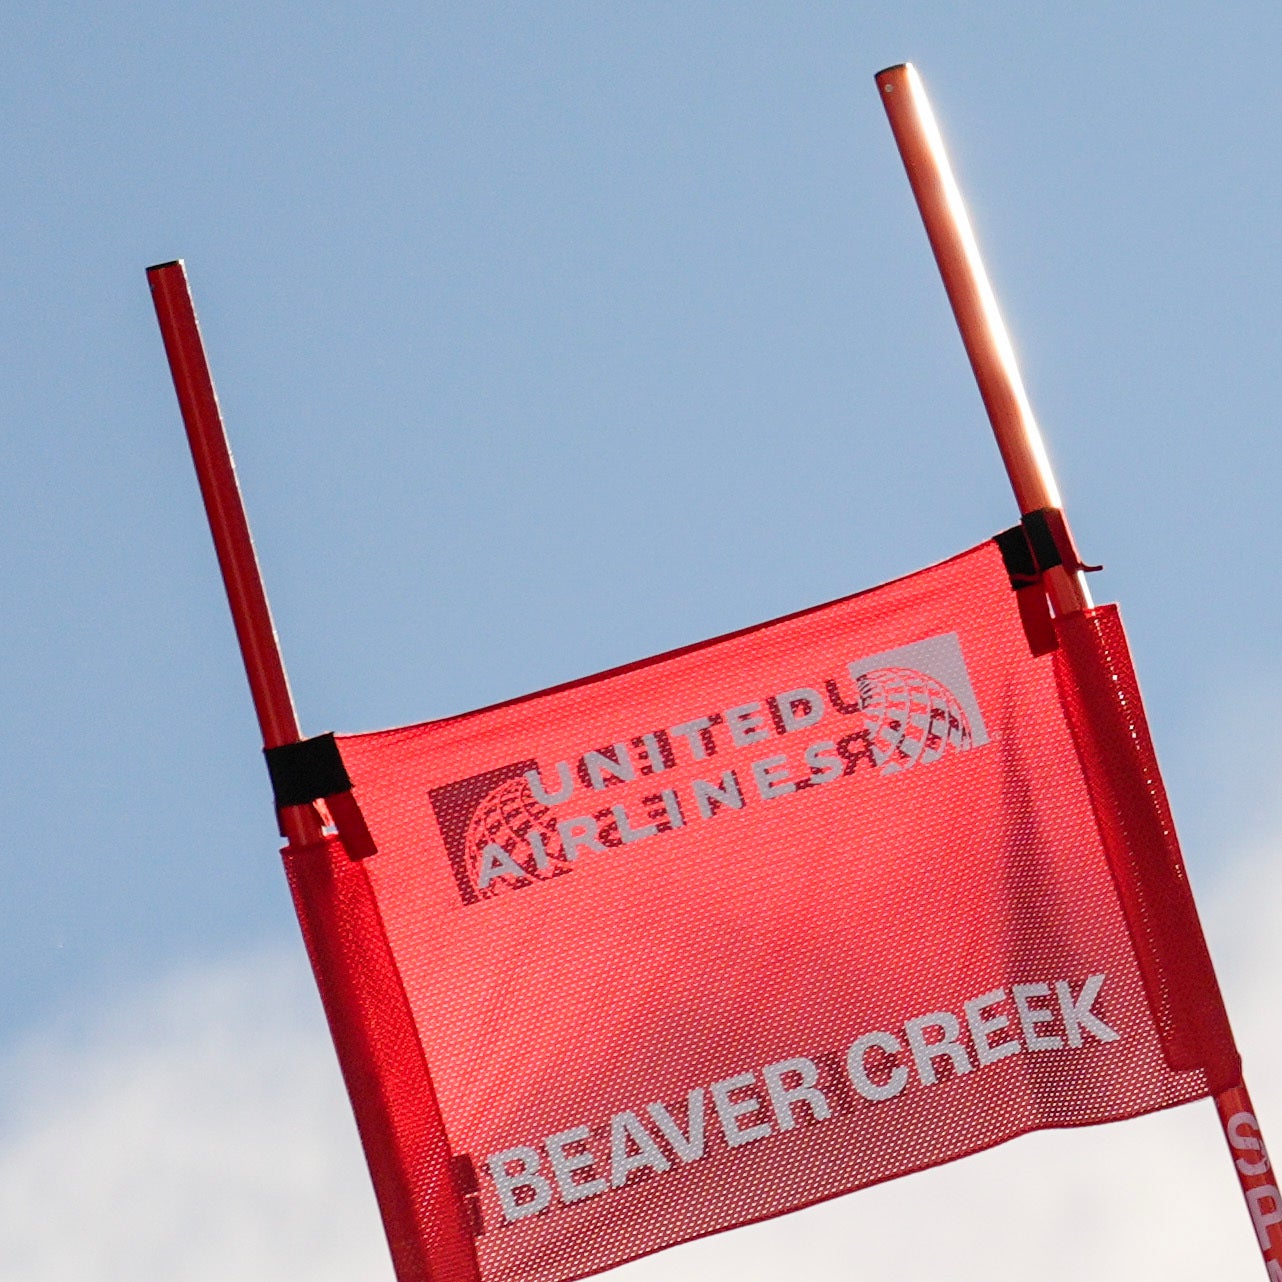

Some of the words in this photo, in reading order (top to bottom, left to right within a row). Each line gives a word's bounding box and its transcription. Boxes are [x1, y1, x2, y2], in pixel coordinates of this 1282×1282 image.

[477, 741, 845, 889] AIRLINES
[525, 687, 824, 807] UNITED
[487, 1055, 830, 1223] BEAVER
[846, 973, 1120, 1102] CREEK
